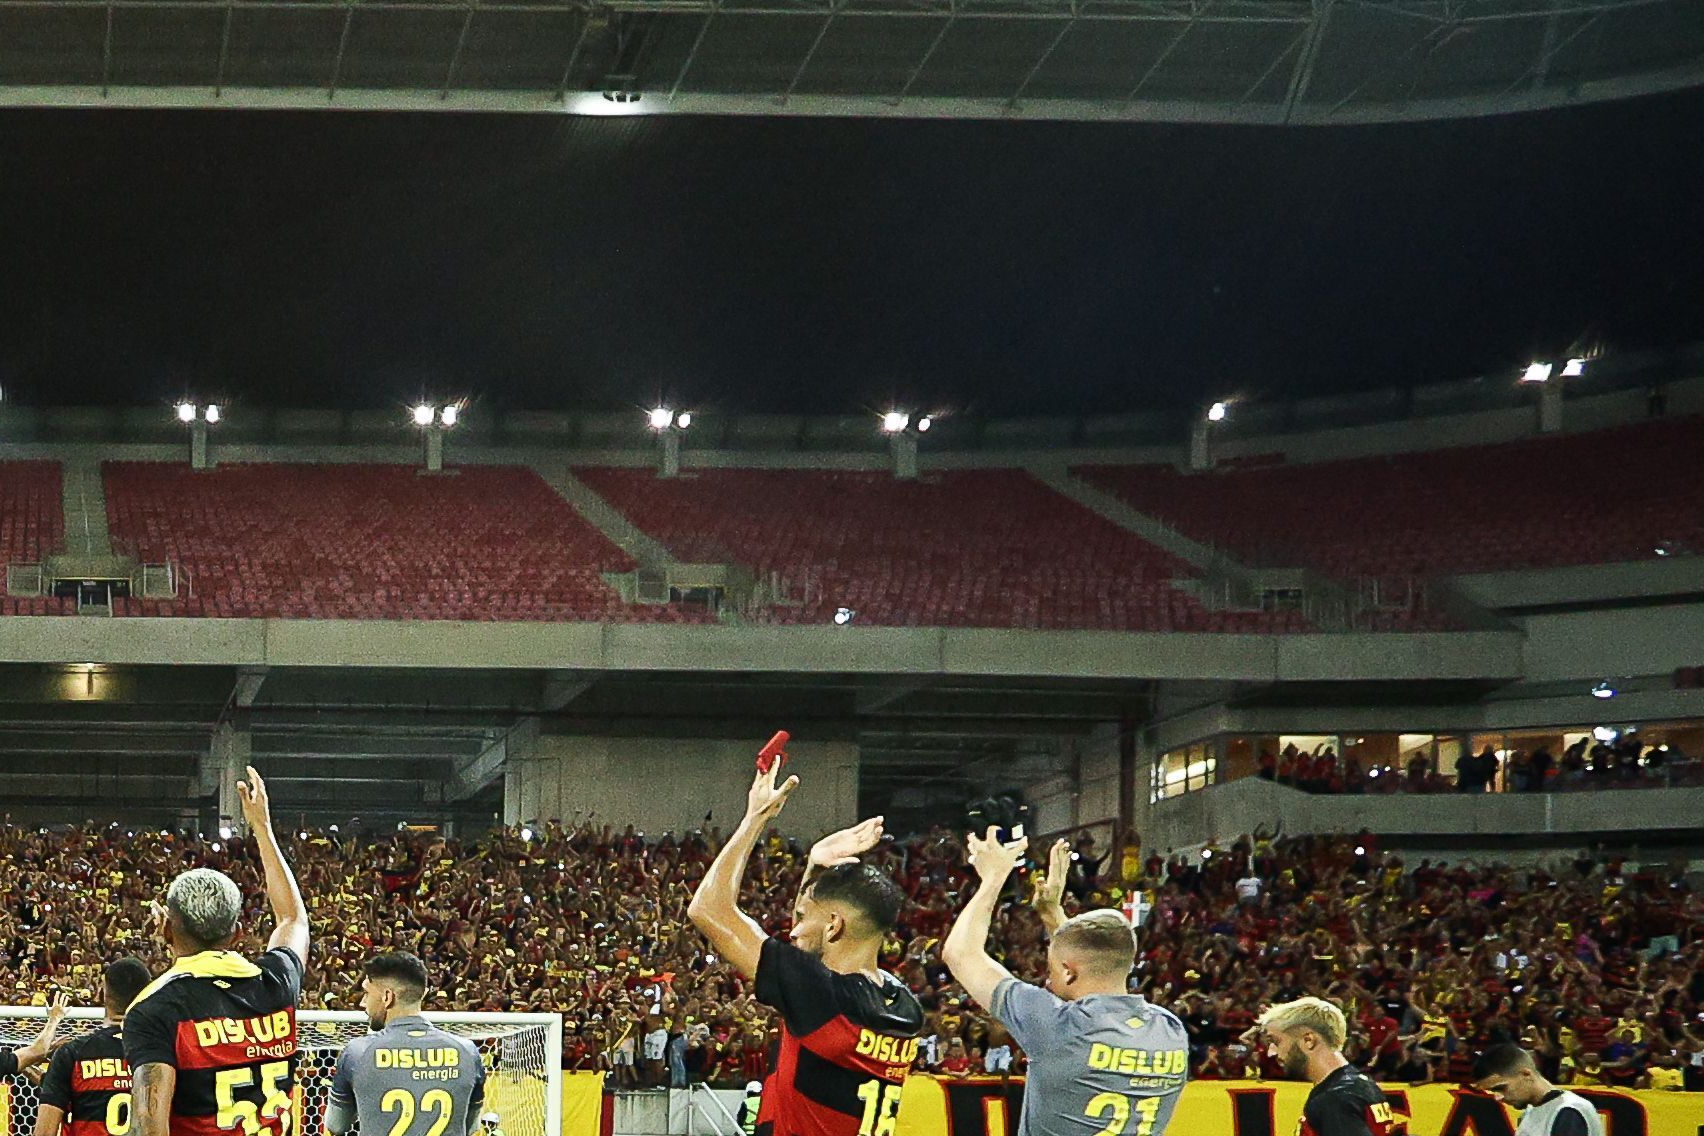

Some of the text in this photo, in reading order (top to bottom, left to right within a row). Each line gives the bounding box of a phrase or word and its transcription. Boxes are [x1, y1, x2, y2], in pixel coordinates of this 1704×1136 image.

[195, 1010, 291, 1047] DISLUB
[375, 1048, 459, 1068] DISLUB
[1087, 1043, 1185, 1074] DISLUB
[81, 1059, 133, 1079] DISL
[412, 1068, 459, 1081] energia
